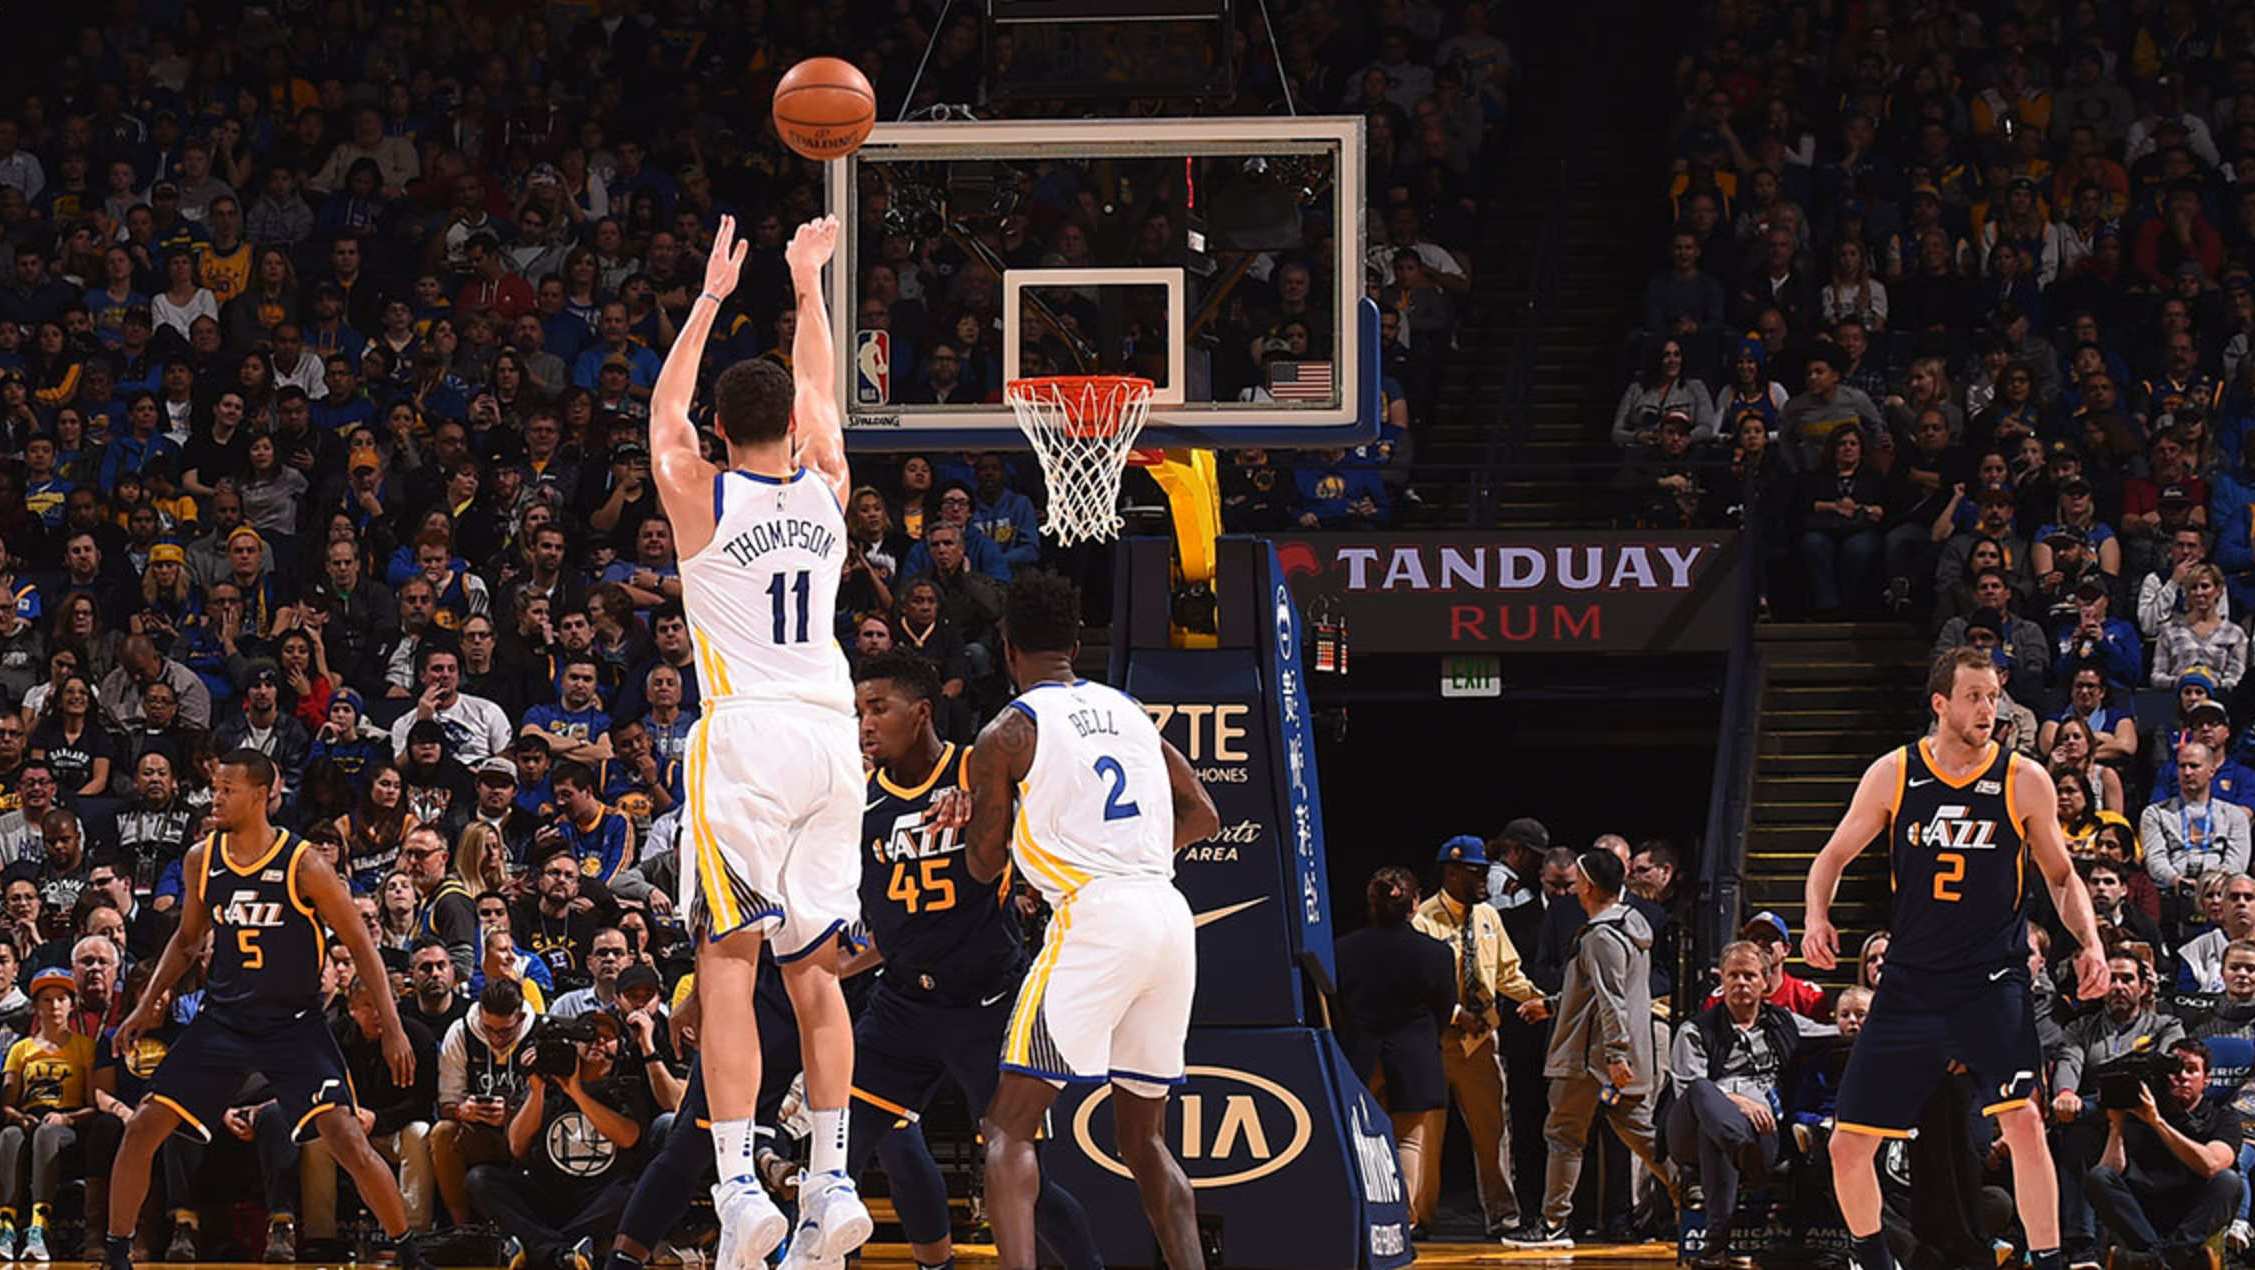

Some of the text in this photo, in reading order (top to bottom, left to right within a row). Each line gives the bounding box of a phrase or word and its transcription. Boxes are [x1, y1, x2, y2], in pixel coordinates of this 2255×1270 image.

[723, 519, 836, 567] THOMPSON
[1336, 546, 1702, 590] TANDUAY
[765, 570, 811, 645] 11
[1451, 603, 1602, 640] RUM
[1452, 660, 1490, 689] EXIT
[1068, 708, 1119, 738] BELL
[1093, 755, 1142, 821] 2
[1196, 767, 1249, 783] HONES
[1907, 804, 1998, 850] JAZZ
[1184, 848, 1239, 861] AREA
[887, 858, 957, 914] 45
[1933, 853, 1966, 902] 2
[213, 890, 285, 927] JAZZ
[237, 929, 264, 969] 5
[1117, 1095, 1271, 1158] IA
